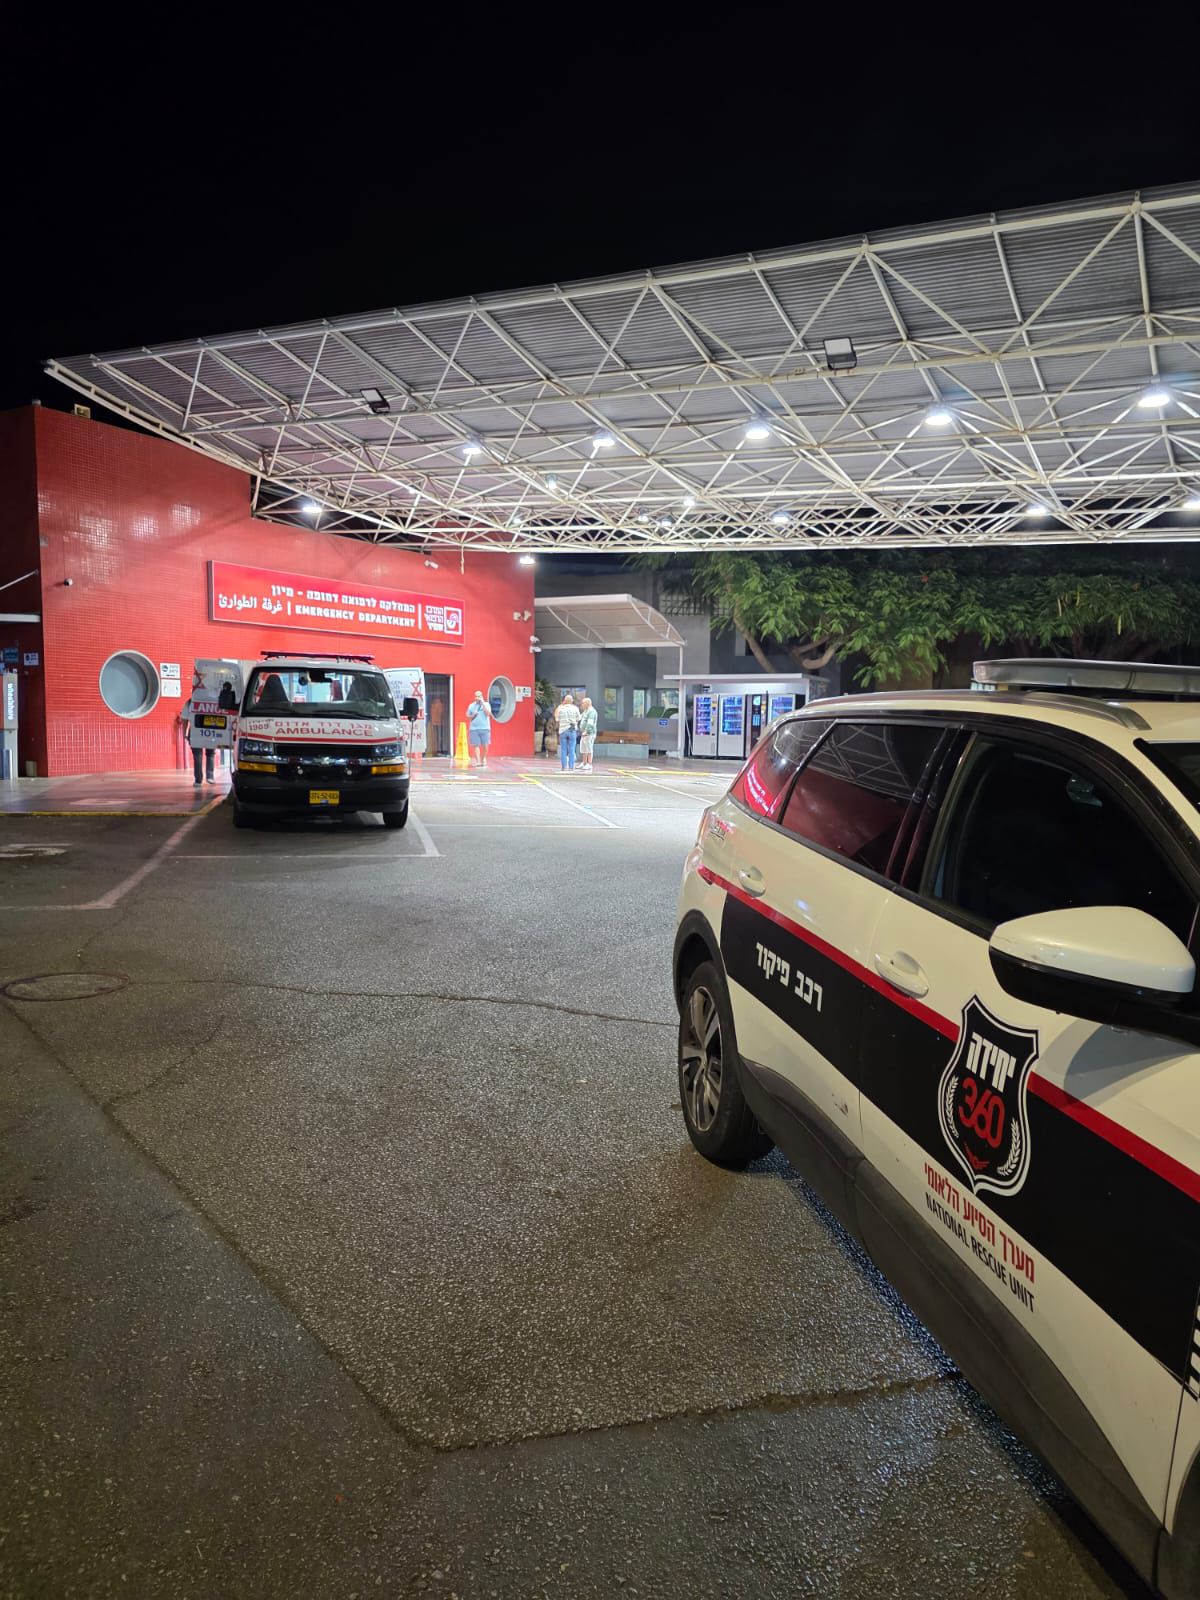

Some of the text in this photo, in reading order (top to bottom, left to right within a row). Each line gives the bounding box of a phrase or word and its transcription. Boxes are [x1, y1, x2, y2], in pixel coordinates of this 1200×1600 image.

[271, 585, 294, 597] מיון
[306, 590, 339, 603] דחופה
[341, 595, 378, 608] לרפואה
[218, 593, 283, 615] غرفة الطوارئ
[379, 600, 416, 613] המחלקה
[295, 604, 416, 627] EMERGENCY DEPARTMENT
[200, 729, 216, 738] 101
[275, 727, 373, 736] AMBULANCE
[756, 941, 823, 1013] רכב פיקוד
[966, 1031, 1017, 1093] יחידה
[958, 1077, 1005, 1148] 360
[924, 1162, 1035, 1284] מערך הסיוע הלאומי
[925, 1192, 1035, 1313] NATIONAL RESCUE UNIT
